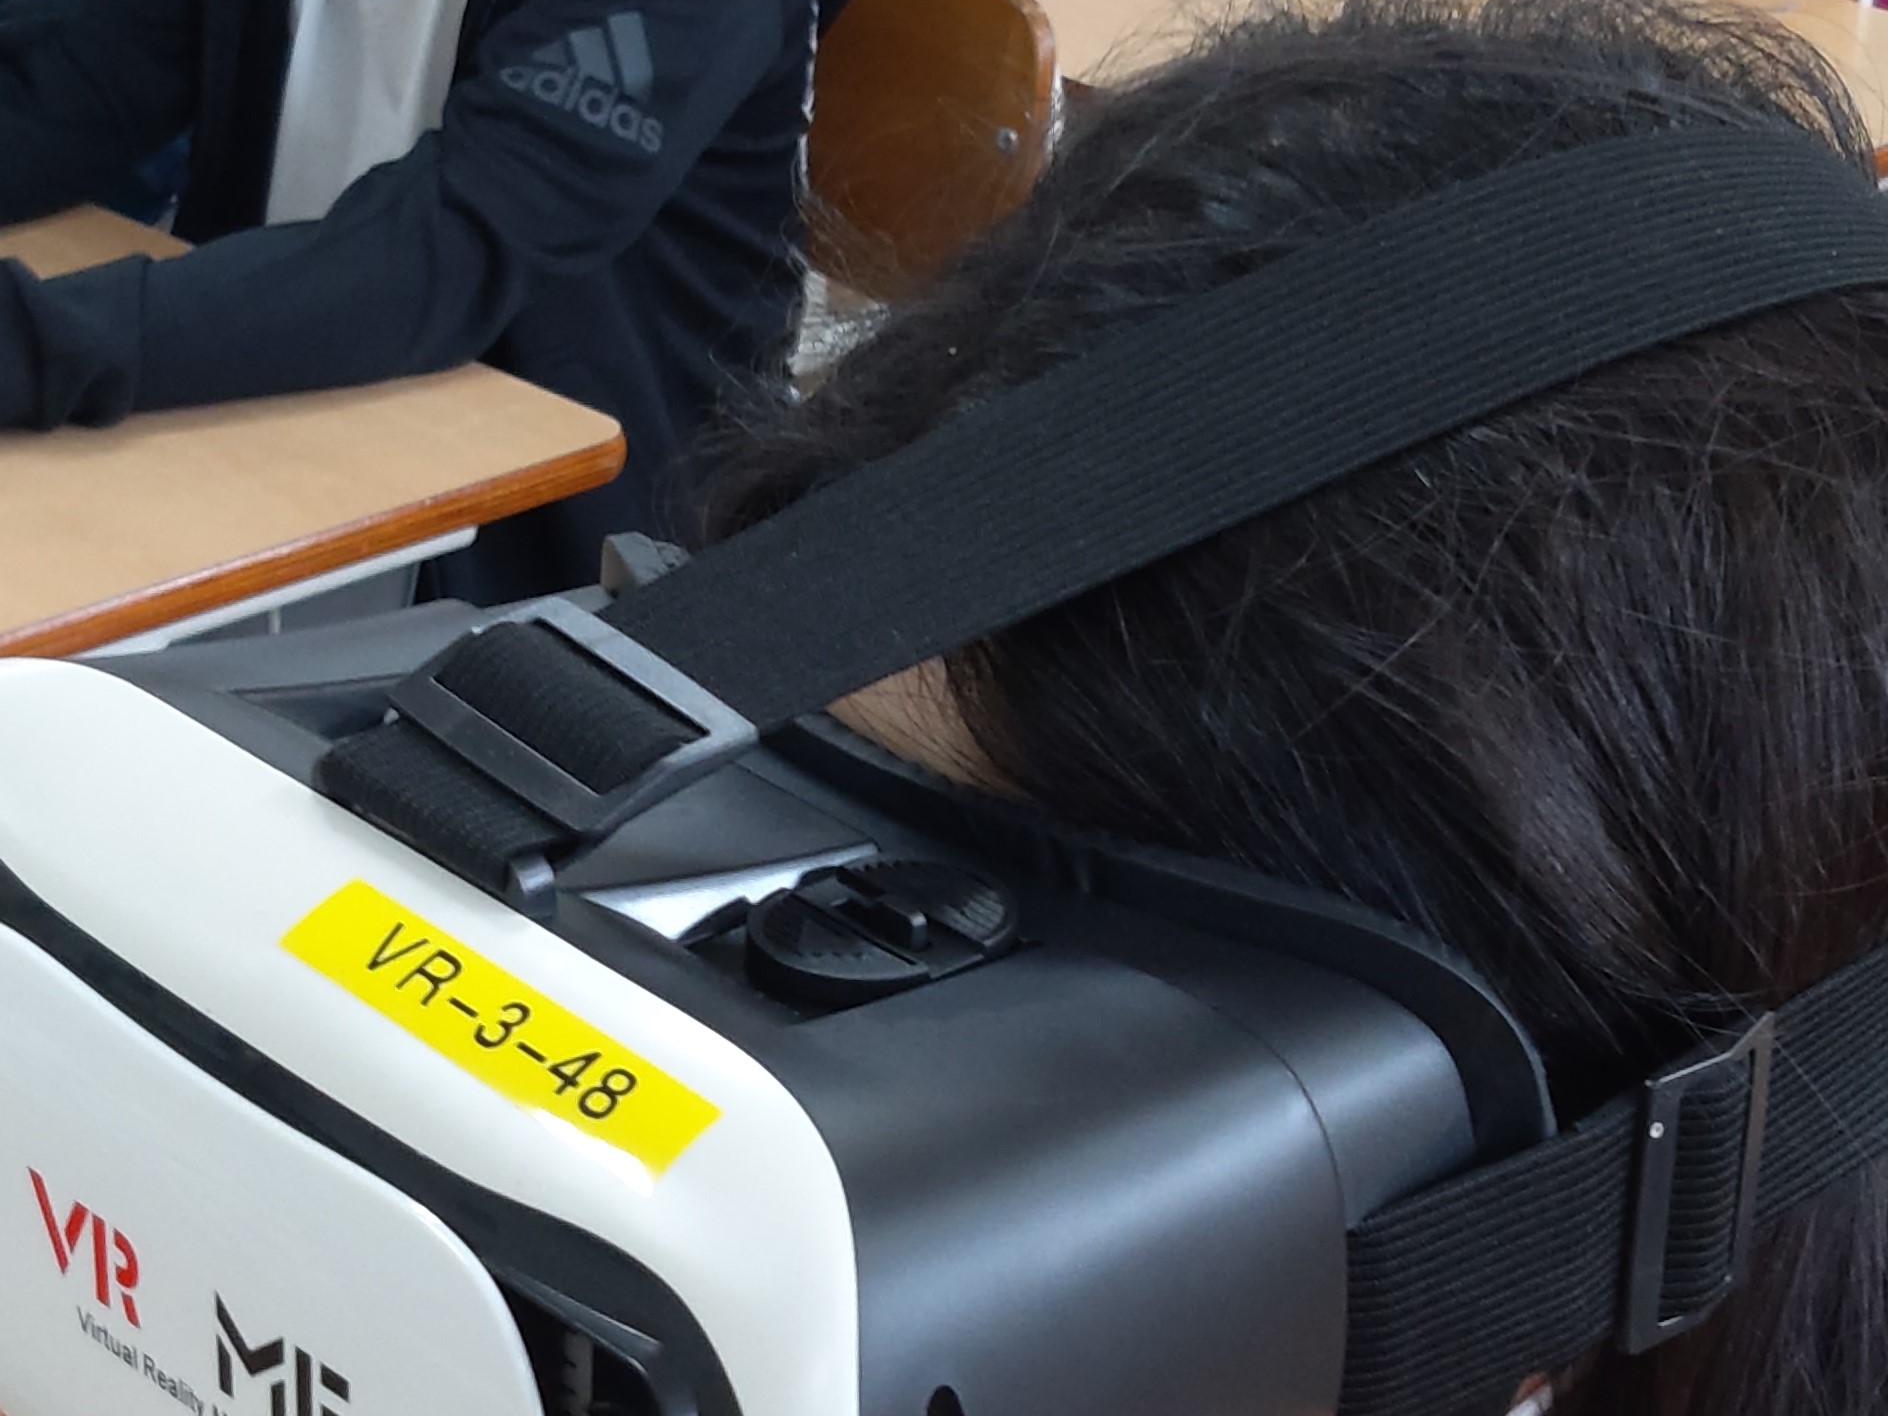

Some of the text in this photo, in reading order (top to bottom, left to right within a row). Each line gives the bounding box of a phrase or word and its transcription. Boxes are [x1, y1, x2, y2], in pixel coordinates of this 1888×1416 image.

[499, 66, 666, 154] adidas
[364, 921, 639, 1121] VR-3-48
[27, 1166, 141, 1329] VR
[77, 1304, 139, 1370] Virtual
